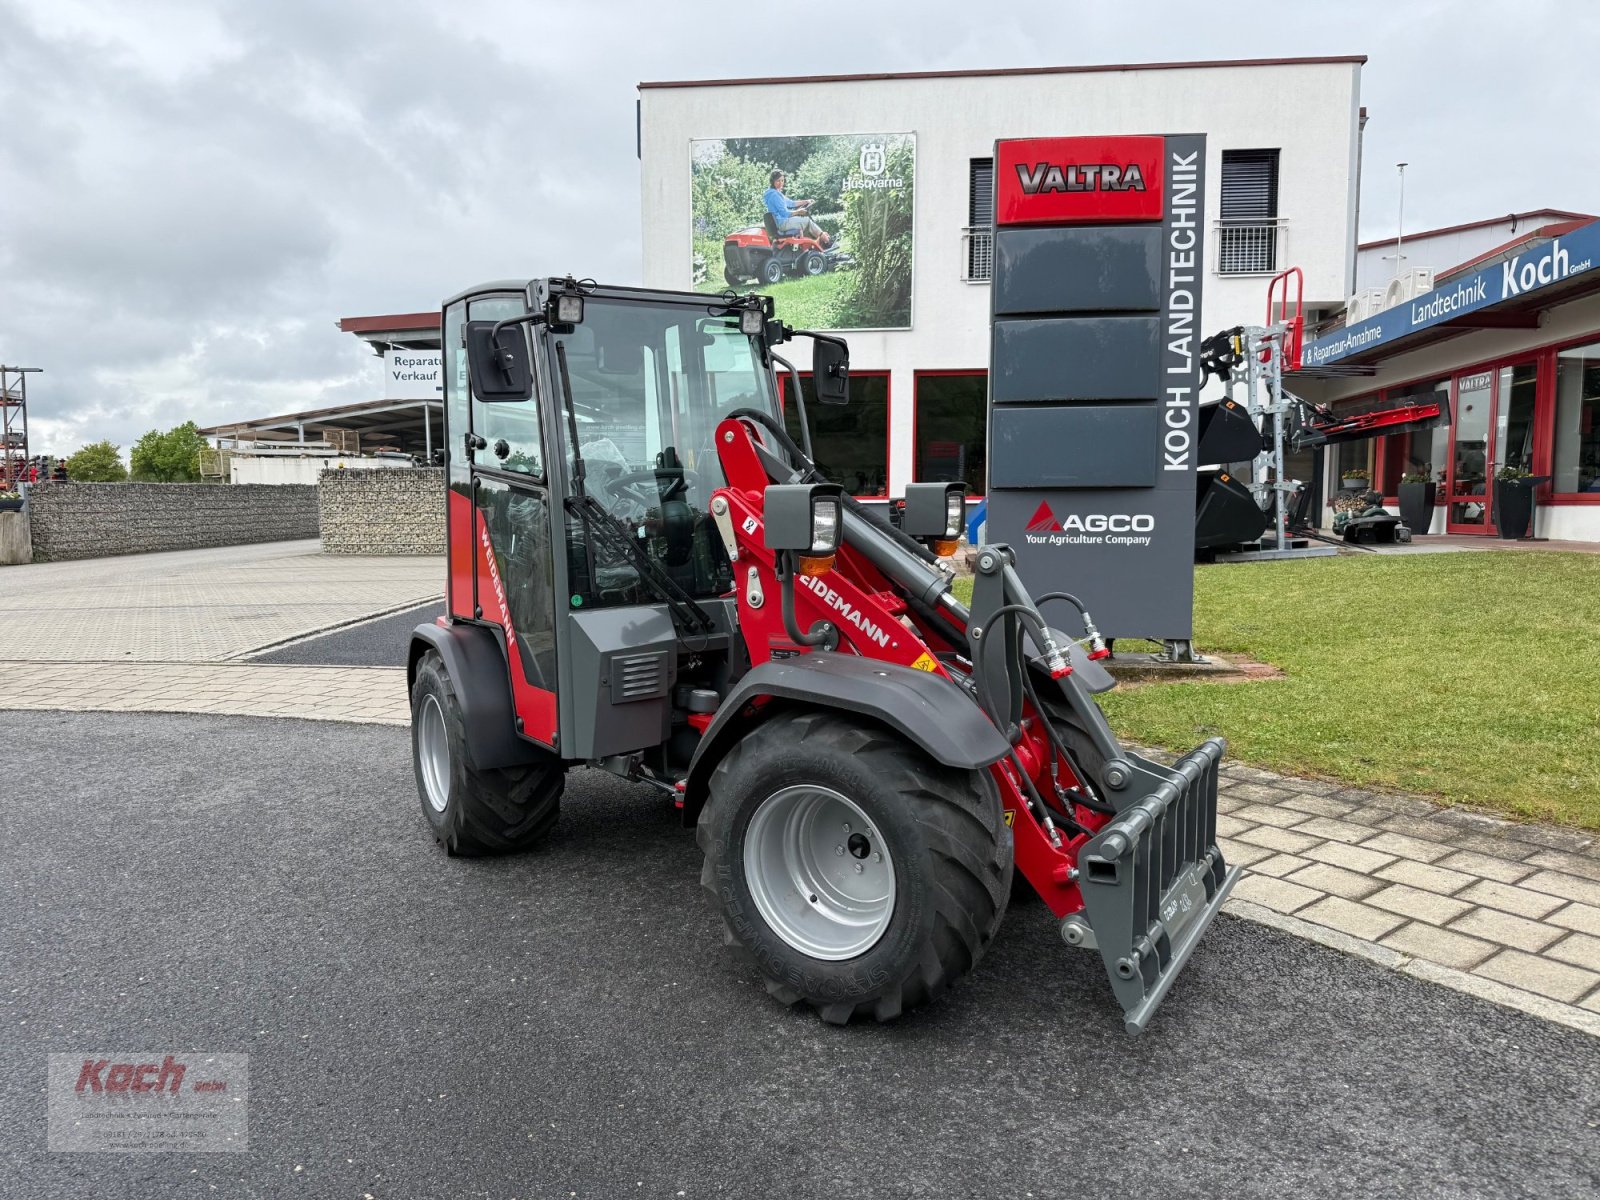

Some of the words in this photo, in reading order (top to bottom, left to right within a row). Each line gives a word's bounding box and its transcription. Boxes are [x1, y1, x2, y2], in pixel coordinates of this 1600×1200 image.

[842, 177, 903, 190] Husqvarna
[1015, 161, 1146, 194] VALTRA
[1167, 151, 1198, 374] LANDTECHNIK
[1411, 275, 1487, 326] Landtechnik
[1501, 240, 1569, 299] Koch
[1569, 258, 1591, 275] GmbH
[1313, 325, 1382, 364] Reparatur-Annahme
[393, 371, 438, 380] Verkauf
[394, 356, 443, 368] Reparatu
[1459, 375, 1491, 391] VALTRA
[1164, 387, 1191, 471] KOCH
[1063, 514, 1155, 532] AGCO
[1026, 534, 1047, 544] Your
[1049, 534, 1103, 546] Agriculture
[1105, 534, 1151, 546] Company
[482, 526, 515, 647] WEIDEMANN
[797, 573, 890, 648] EIDEMANN
